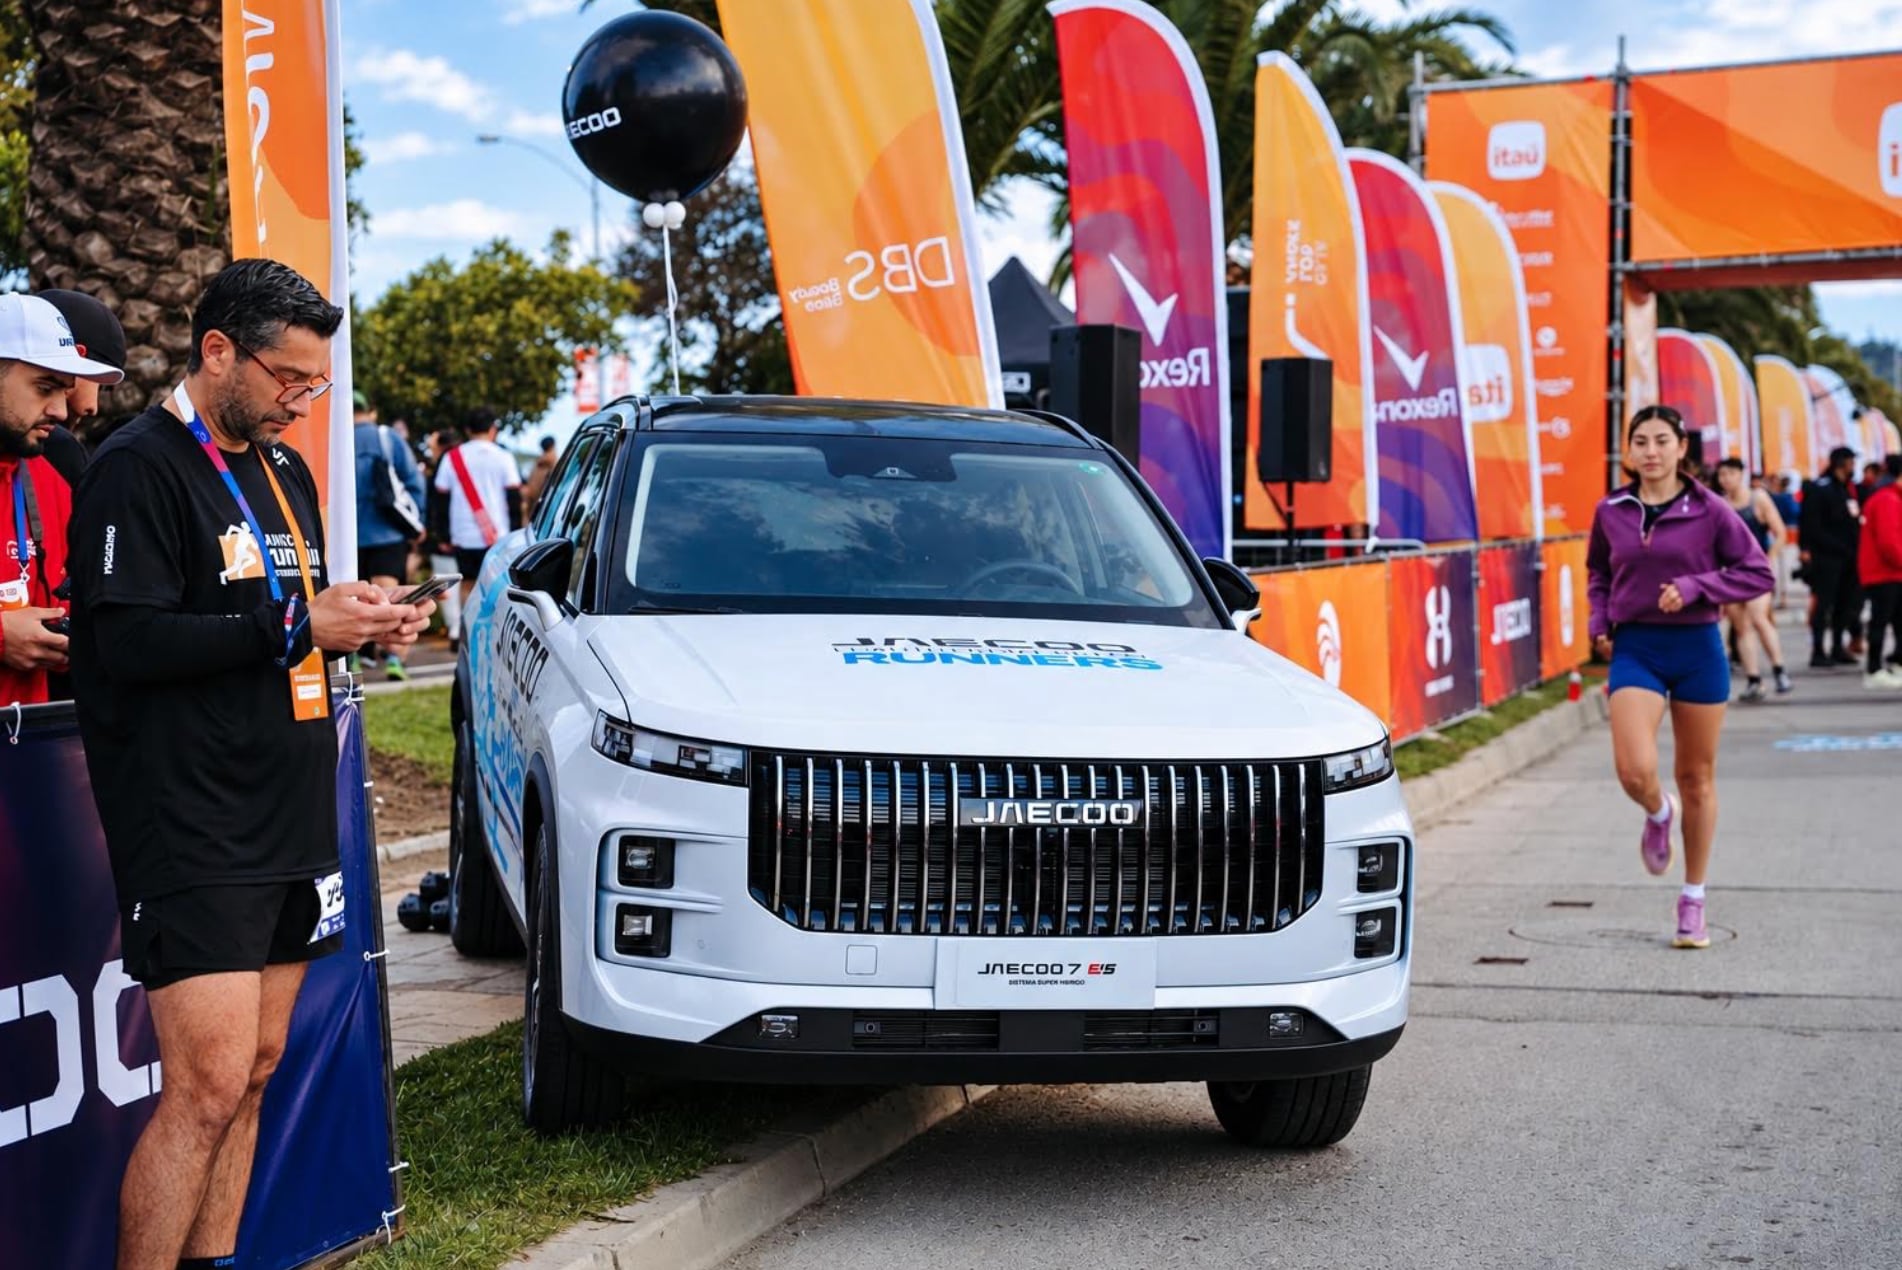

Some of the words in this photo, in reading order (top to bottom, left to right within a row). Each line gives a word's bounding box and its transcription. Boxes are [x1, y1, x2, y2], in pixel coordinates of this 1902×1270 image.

[831, 637, 1137, 653] JAECOO
[843, 651, 1163, 671] RUNNERS
[971, 802, 1134, 824] JAECOO
[977, 963, 1063, 975] JAECOO
[1067, 963, 1082, 975] 7
